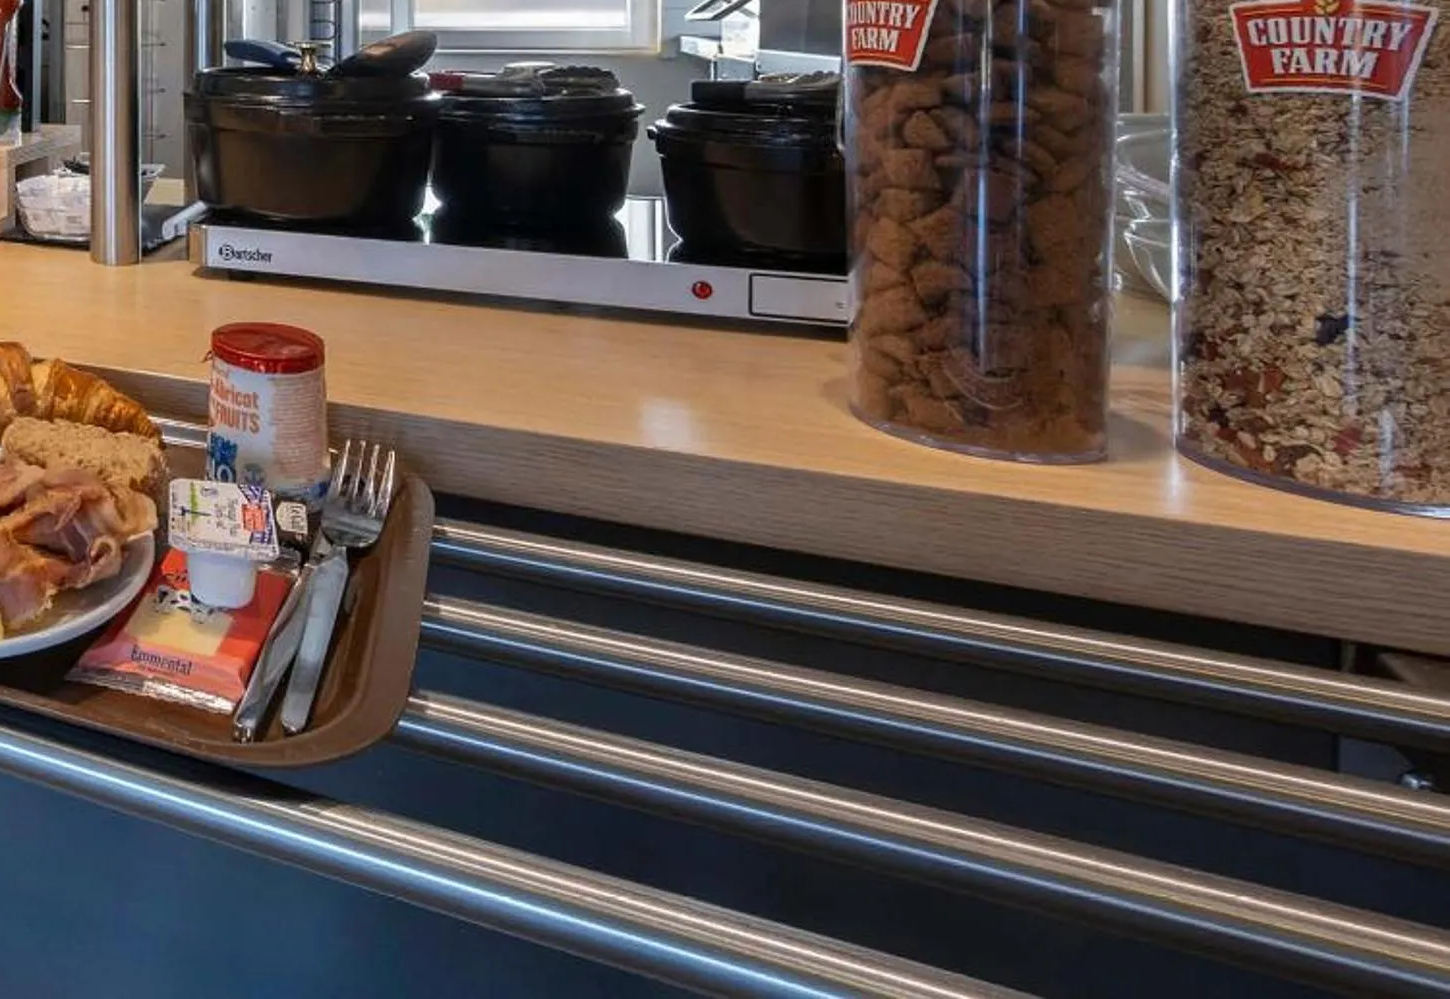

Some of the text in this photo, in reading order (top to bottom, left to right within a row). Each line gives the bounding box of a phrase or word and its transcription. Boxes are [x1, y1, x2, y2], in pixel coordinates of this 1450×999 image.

[852, 26, 900, 52] FARM
[1246, 16, 1414, 51] COUNTRY
[1270, 46, 1379, 78] FARM
[130, 642, 192, 677] Emmental
